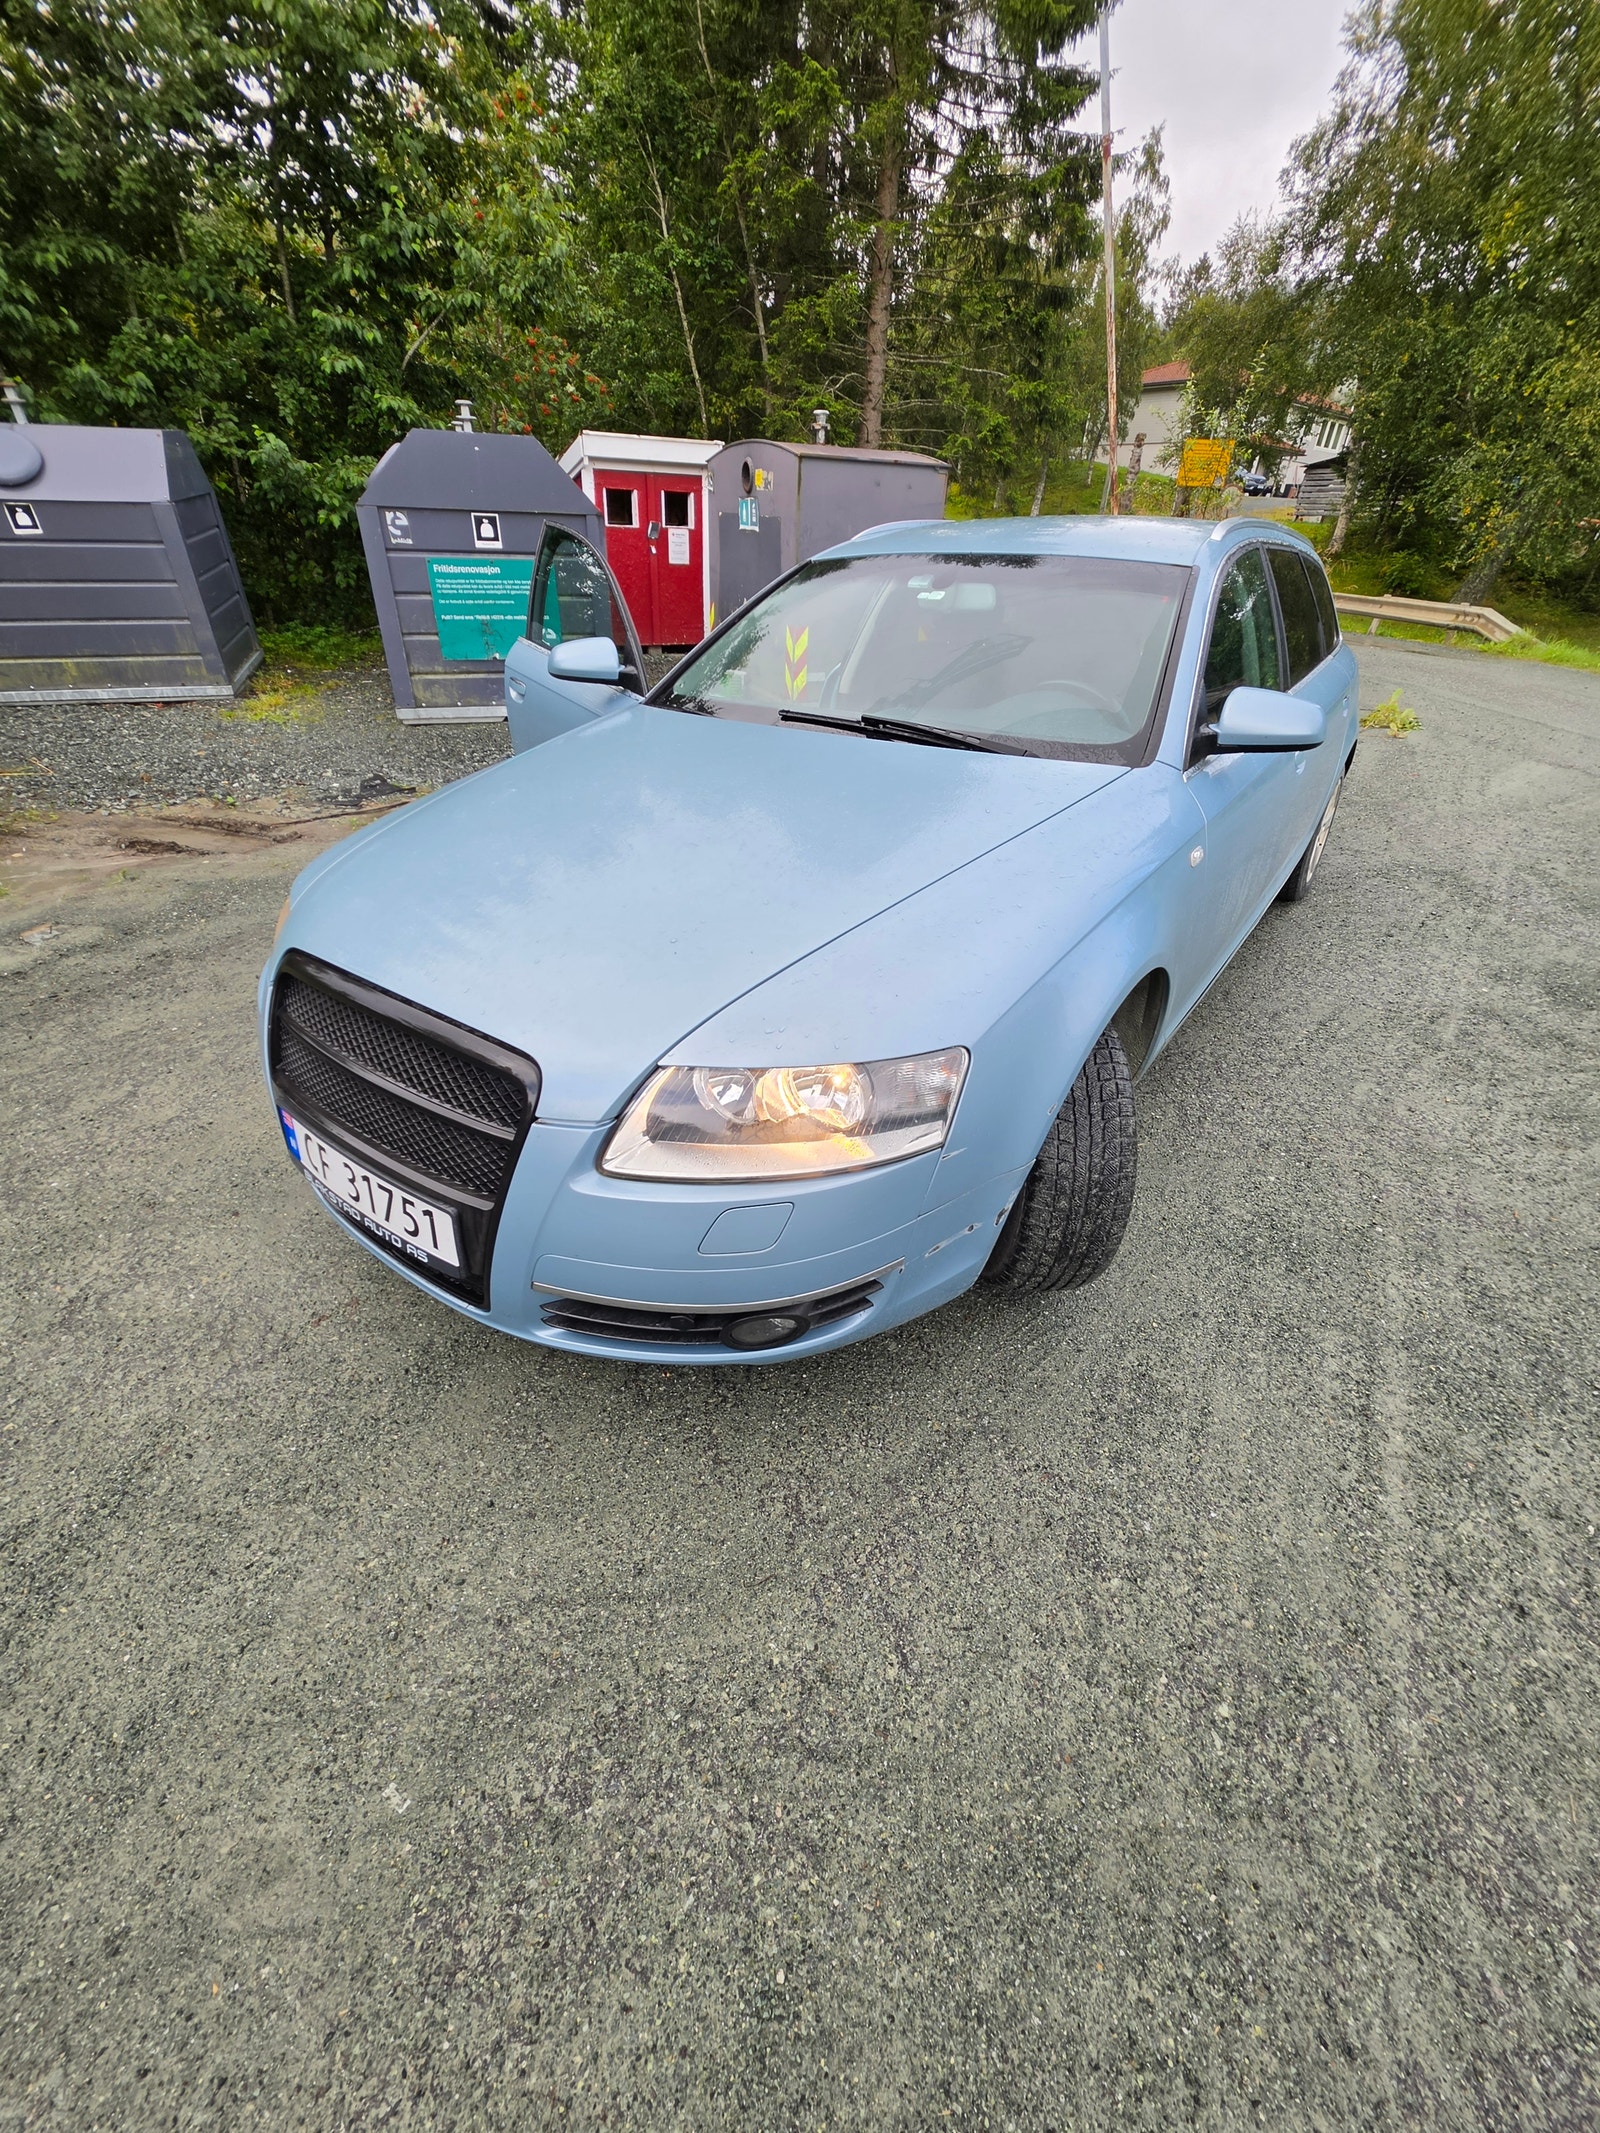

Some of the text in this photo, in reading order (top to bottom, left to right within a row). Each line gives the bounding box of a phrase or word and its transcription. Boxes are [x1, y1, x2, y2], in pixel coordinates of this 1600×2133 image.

[433, 564, 501, 575] Fritidsrenovasjon
[304, 1133, 439, 1250] CF 31751
[364, 1216, 402, 1248] AUTO
[406, 1244, 429, 1263] AS
